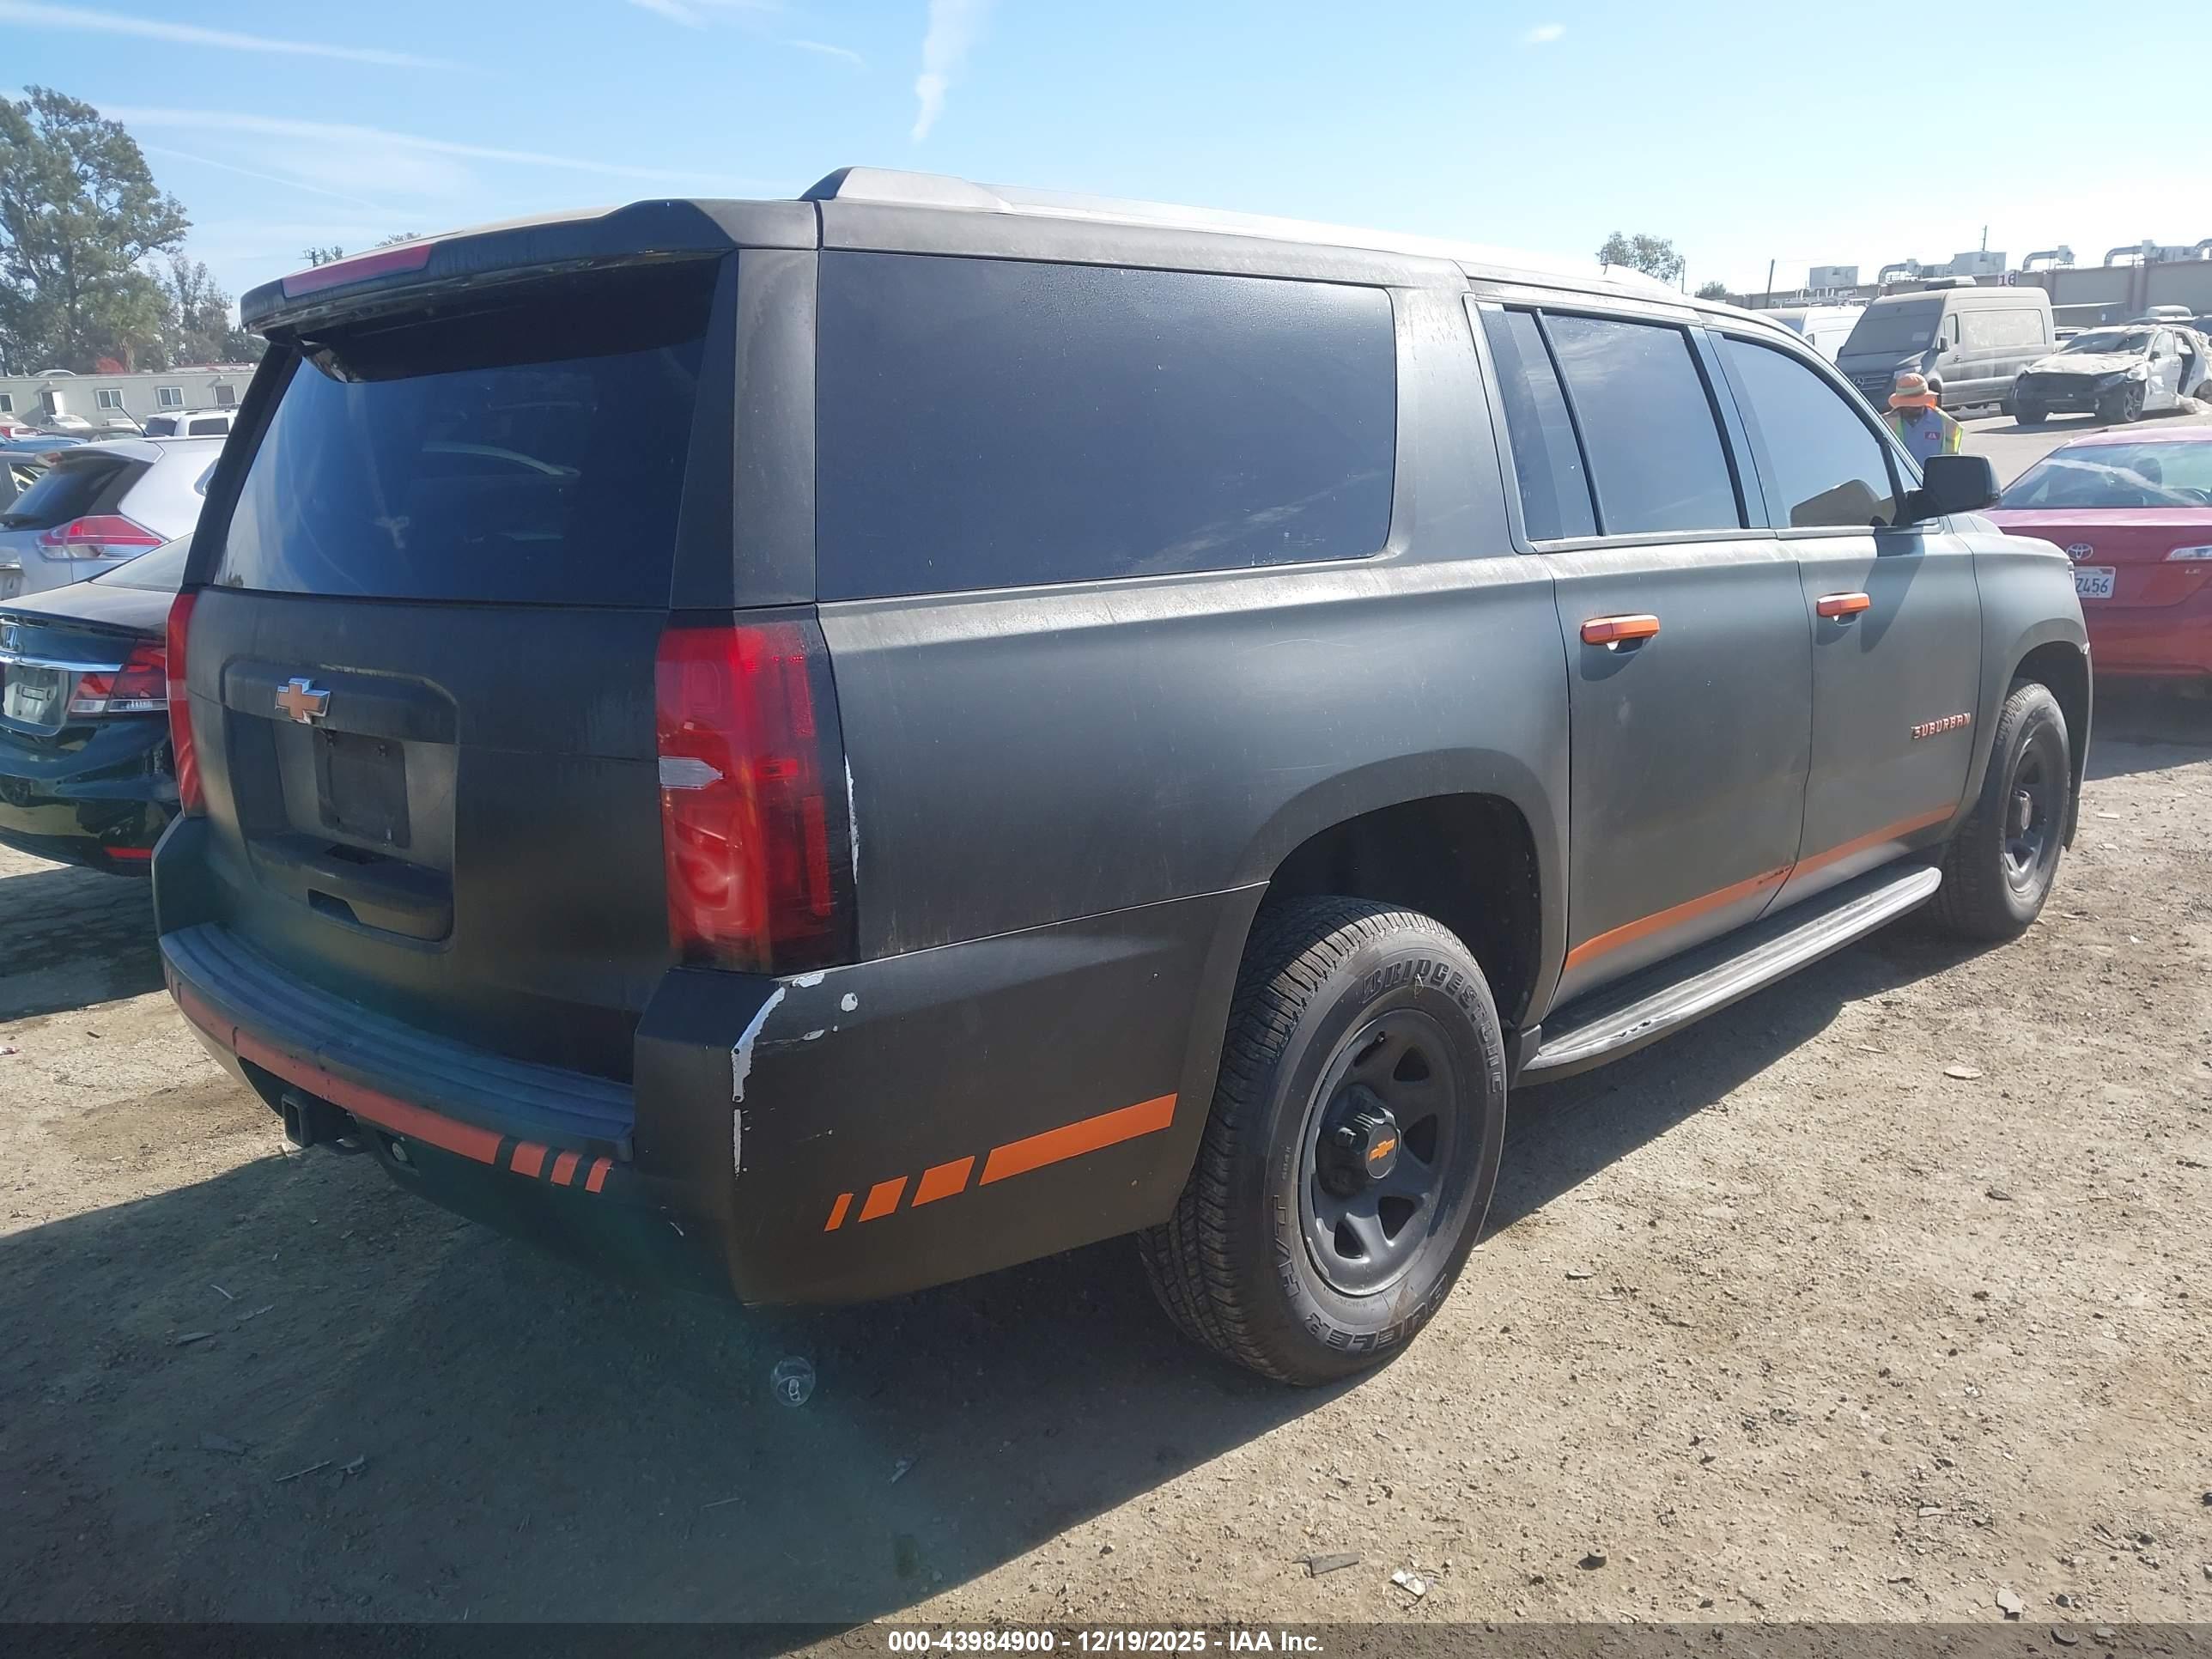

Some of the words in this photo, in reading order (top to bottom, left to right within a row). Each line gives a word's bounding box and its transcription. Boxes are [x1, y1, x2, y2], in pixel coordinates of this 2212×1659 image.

[1911, 712, 1972, 739] SUBURBAN
[1362, 958, 1503, 1094] BRIDGESTONE
[1304, 1273, 1449, 1352] DUELER
